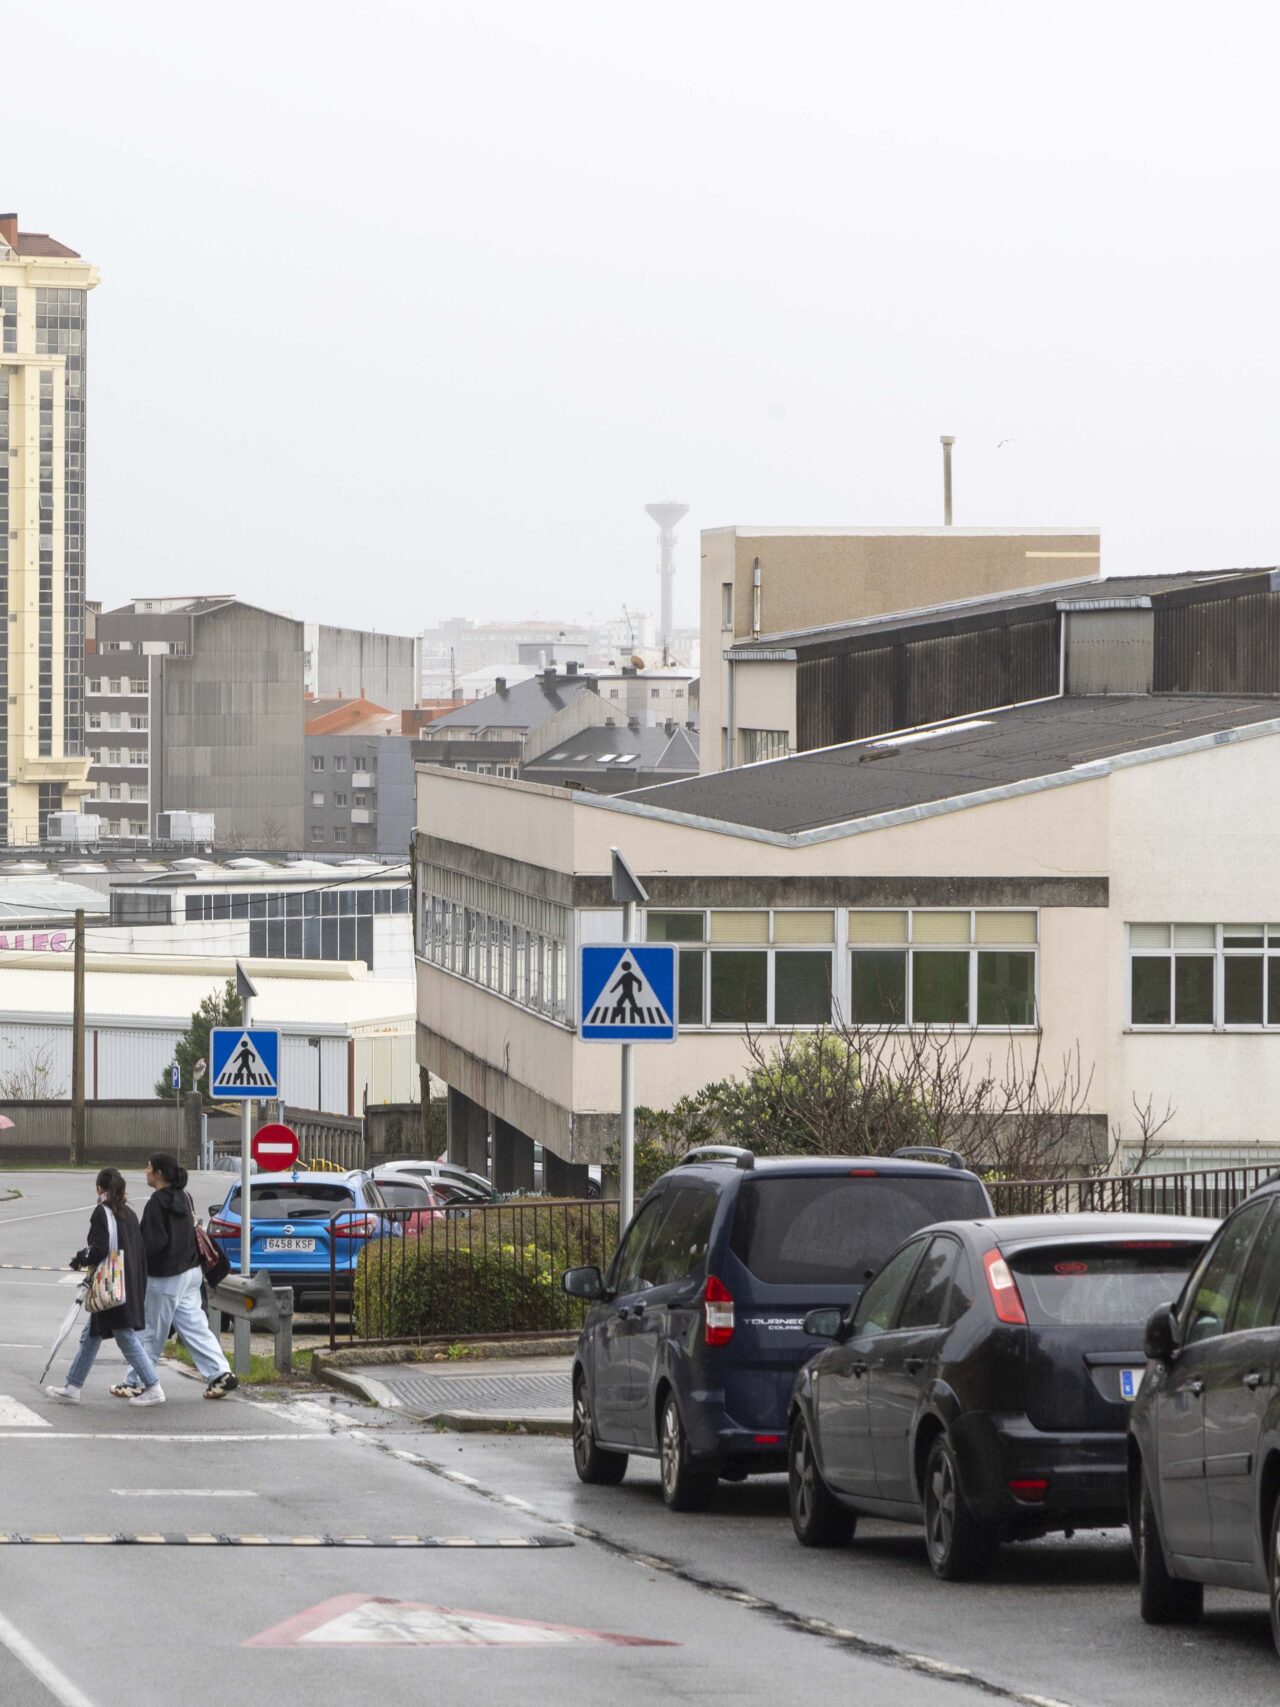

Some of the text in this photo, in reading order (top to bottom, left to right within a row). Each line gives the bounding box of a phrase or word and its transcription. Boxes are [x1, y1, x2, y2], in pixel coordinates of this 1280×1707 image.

[172, 1068, 178, 1086] P
[268, 1239, 313, 1249] 6458 KSF
